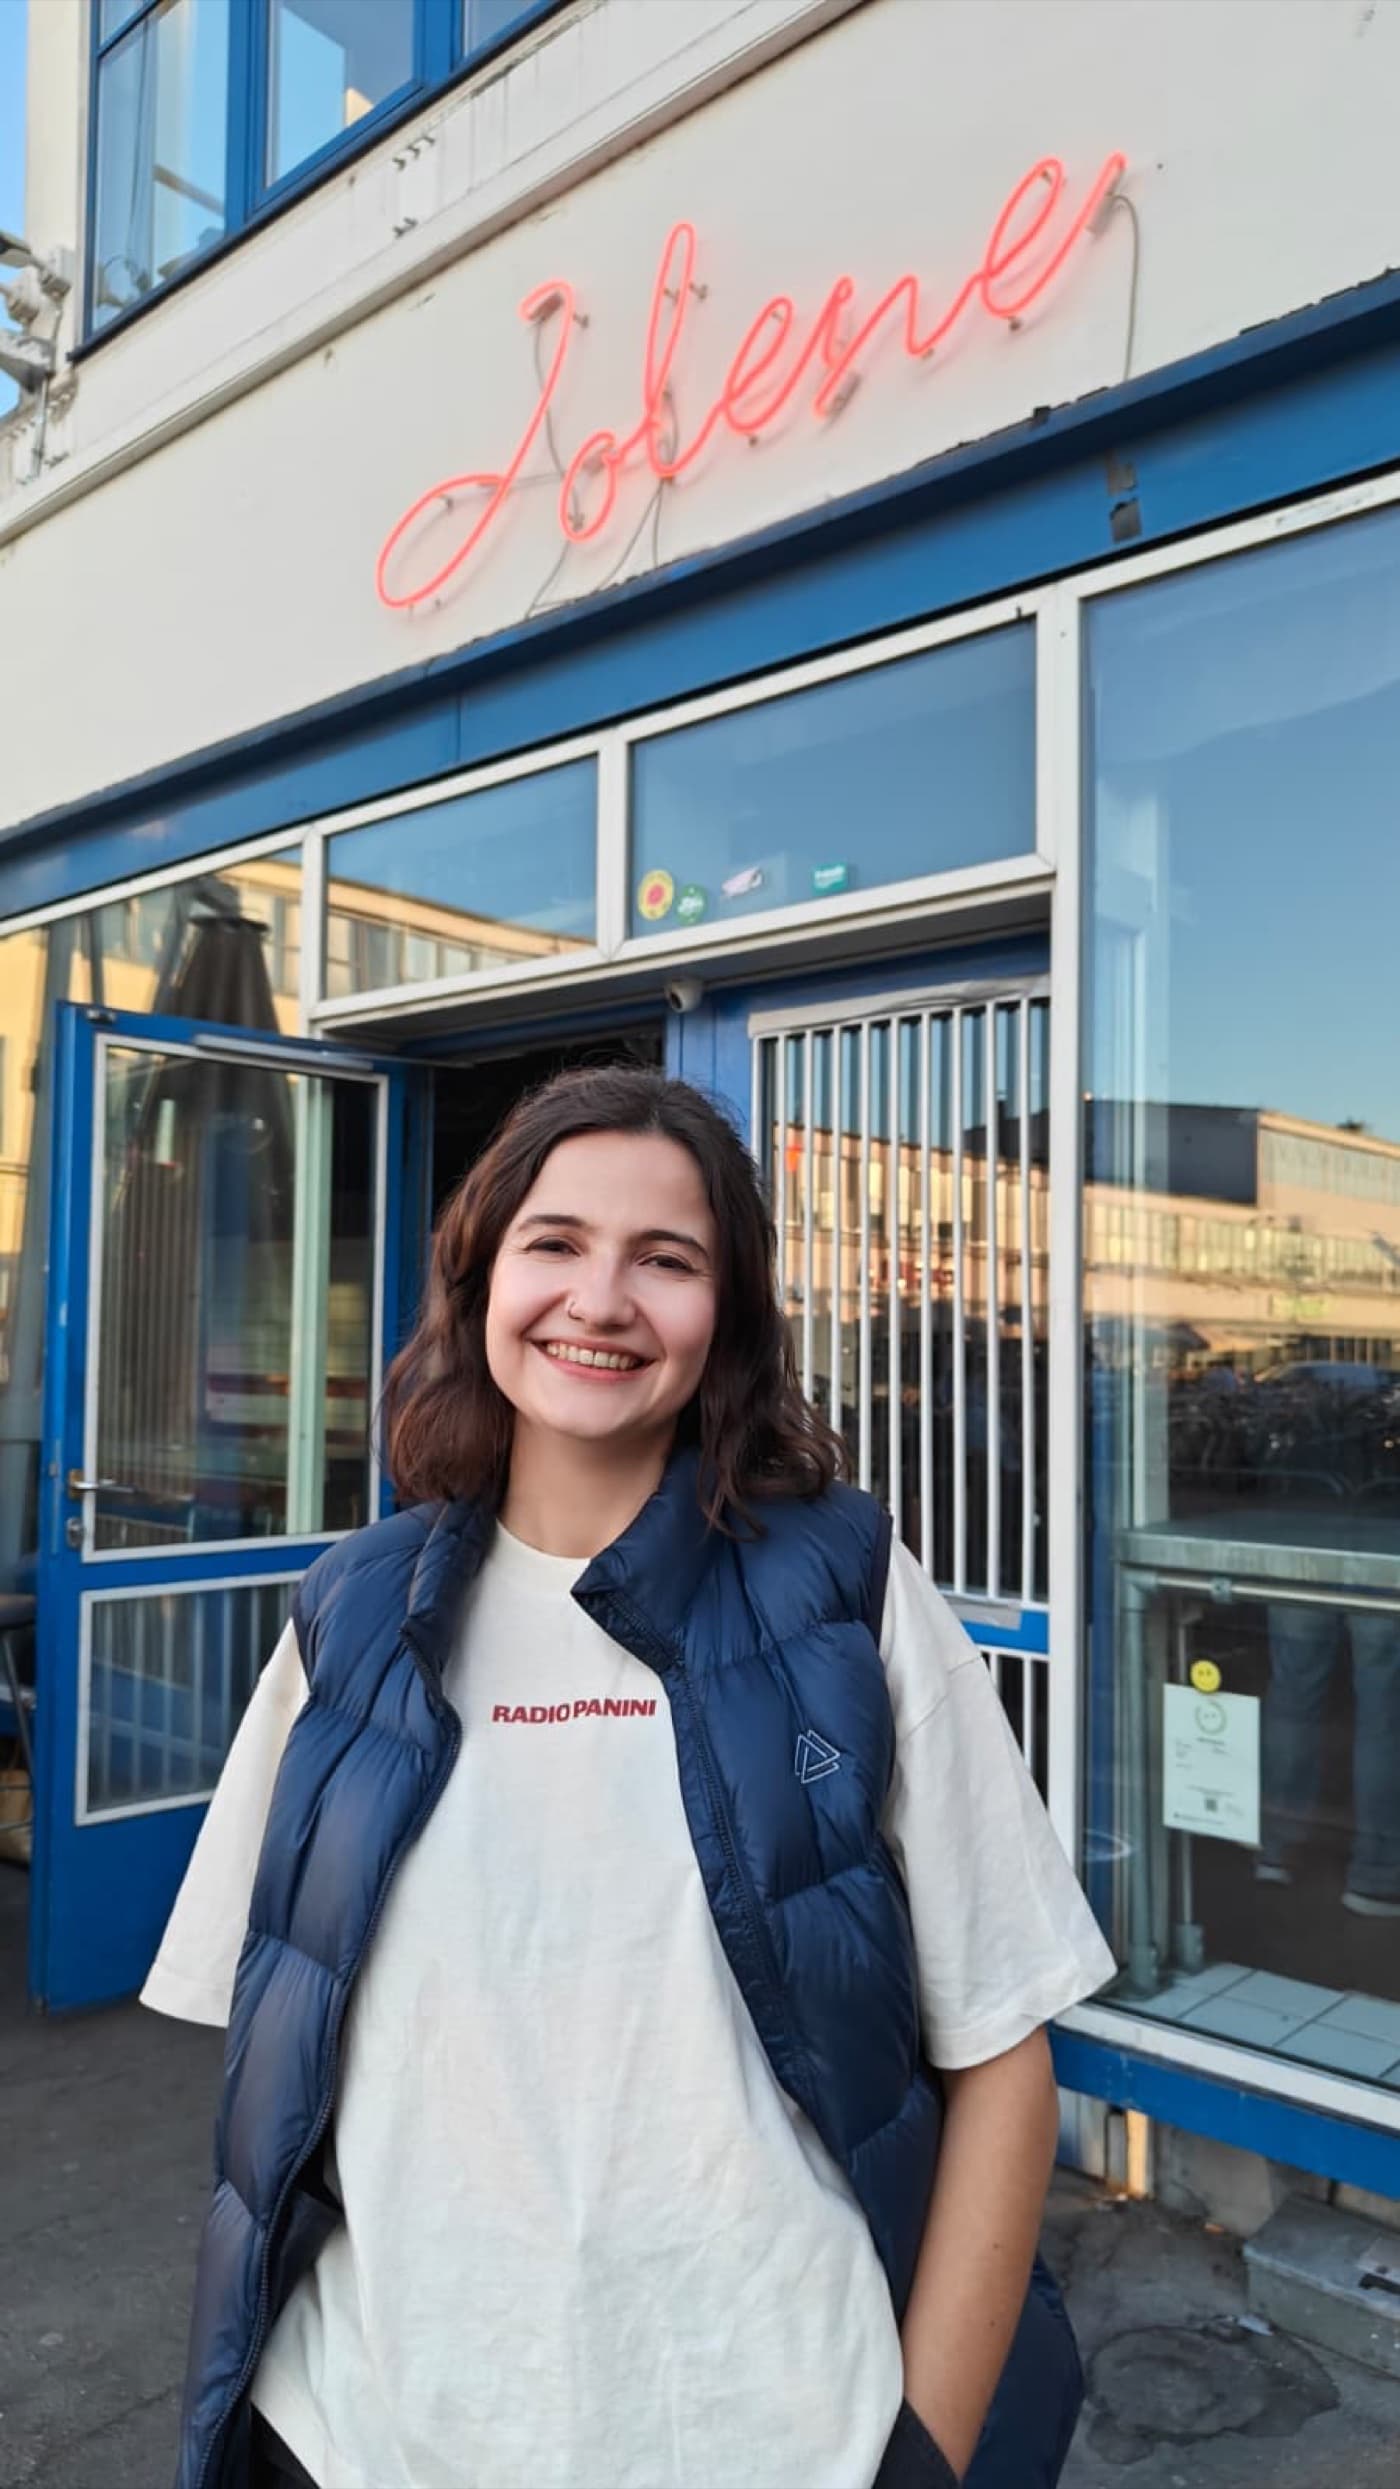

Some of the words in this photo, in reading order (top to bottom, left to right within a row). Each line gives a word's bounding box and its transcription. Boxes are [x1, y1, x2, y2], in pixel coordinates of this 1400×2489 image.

[376, 153, 1127, 607] Jolene
[493, 1704, 570, 1723] RADIO
[574, 1699, 657, 1717] PANINI
